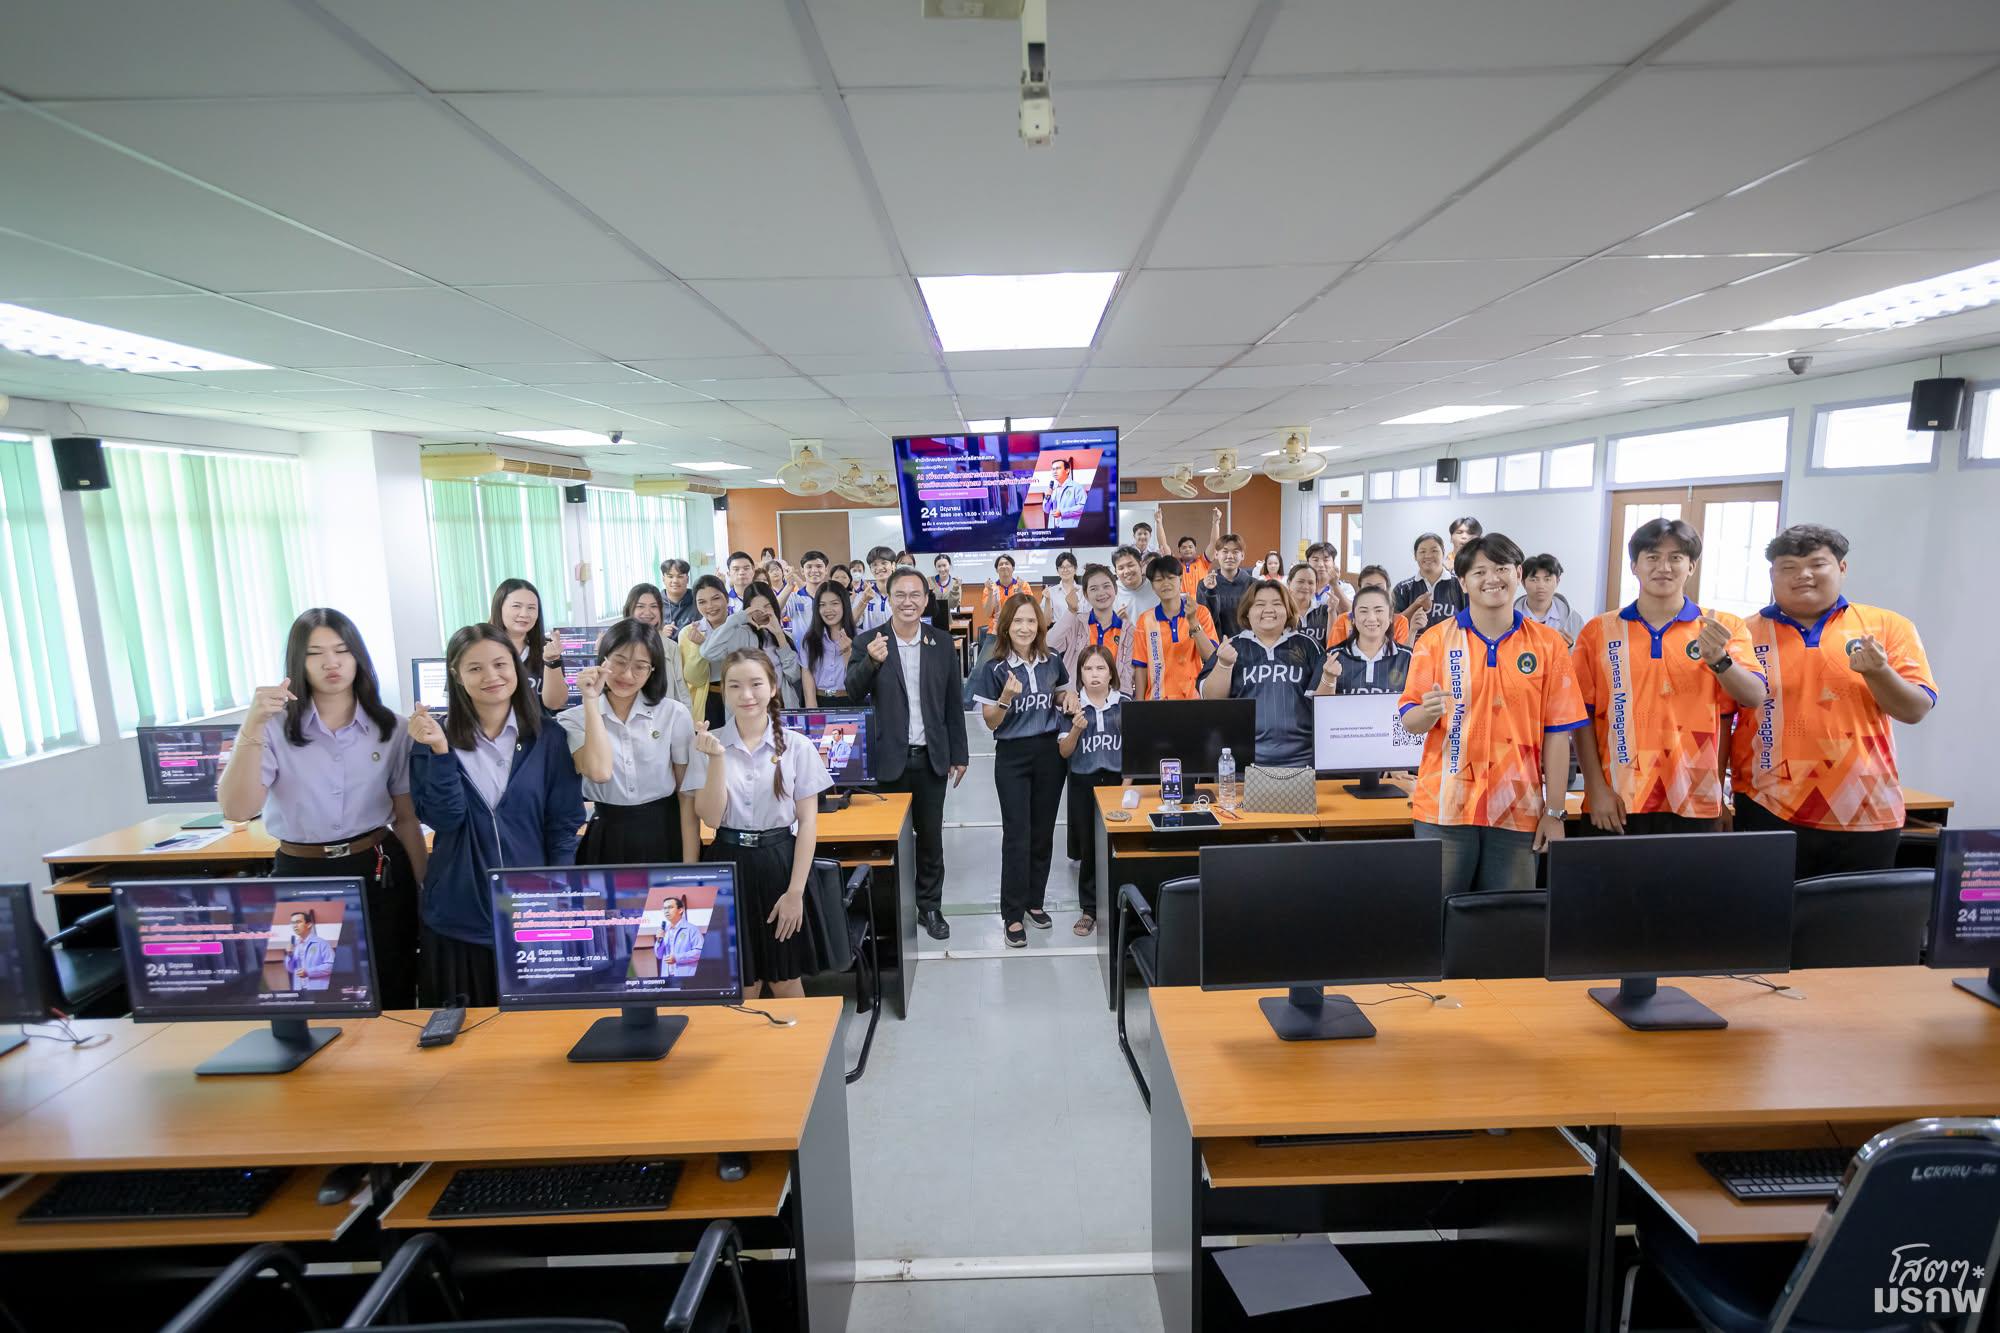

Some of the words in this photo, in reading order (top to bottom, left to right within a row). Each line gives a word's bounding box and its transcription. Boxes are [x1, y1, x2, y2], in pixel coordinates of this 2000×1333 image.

[920, 507, 938, 519] 24
[1242, 664, 1303, 686] KPRU
[1449, 649, 1463, 700] Business
[1608, 640, 1622, 689] Business
[1015, 693, 1053, 714] KPRU
[1613, 692, 1630, 764] Management
[1082, 734, 1122, 754] KPRU
[1448, 703, 1466, 775] Management
[1957, 908, 1977, 922] 24
[516, 950, 536, 964] 24
[146, 963, 167, 977] 24
